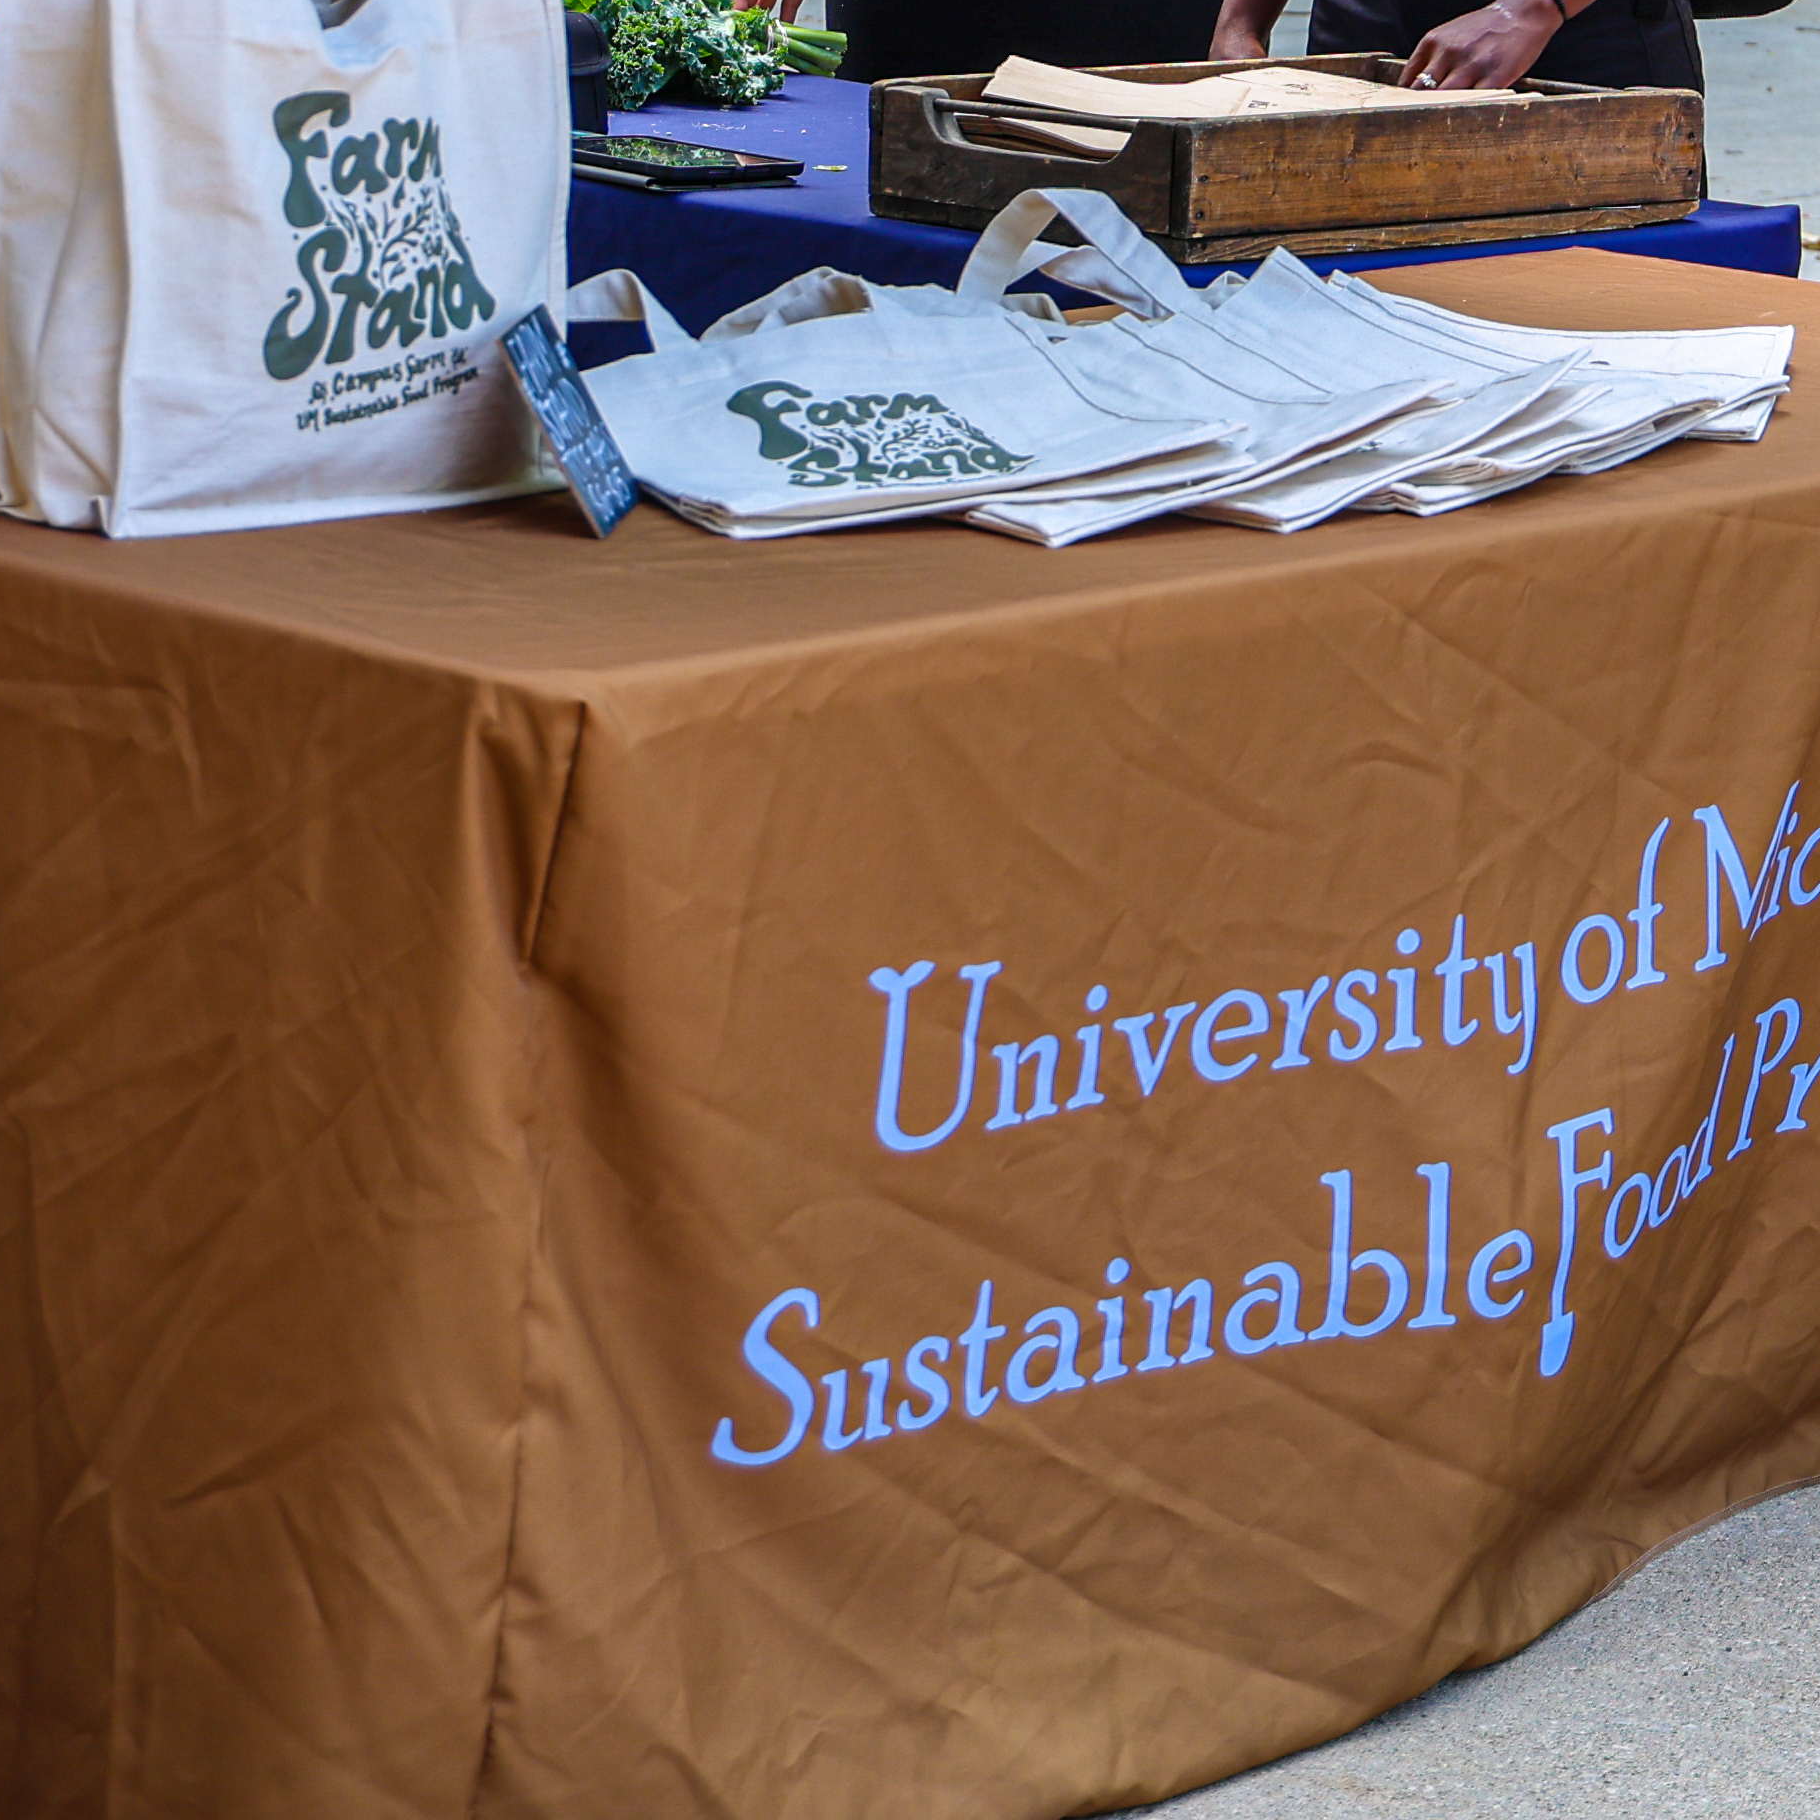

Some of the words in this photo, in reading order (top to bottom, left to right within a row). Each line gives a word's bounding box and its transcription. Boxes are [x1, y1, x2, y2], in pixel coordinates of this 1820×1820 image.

[273, 89, 442, 228] Farm
[262, 185, 497, 381] Stand
[333, 363, 402, 396] Campus
[726, 379, 949, 461] Farm
[786, 426, 1036, 488] Stand
[868, 916, 1539, 1153] University
[1559, 818, 1671, 1005] of
[710, 1161, 1534, 1469] Sustainable
[1539, 1034, 1736, 1378] Food
